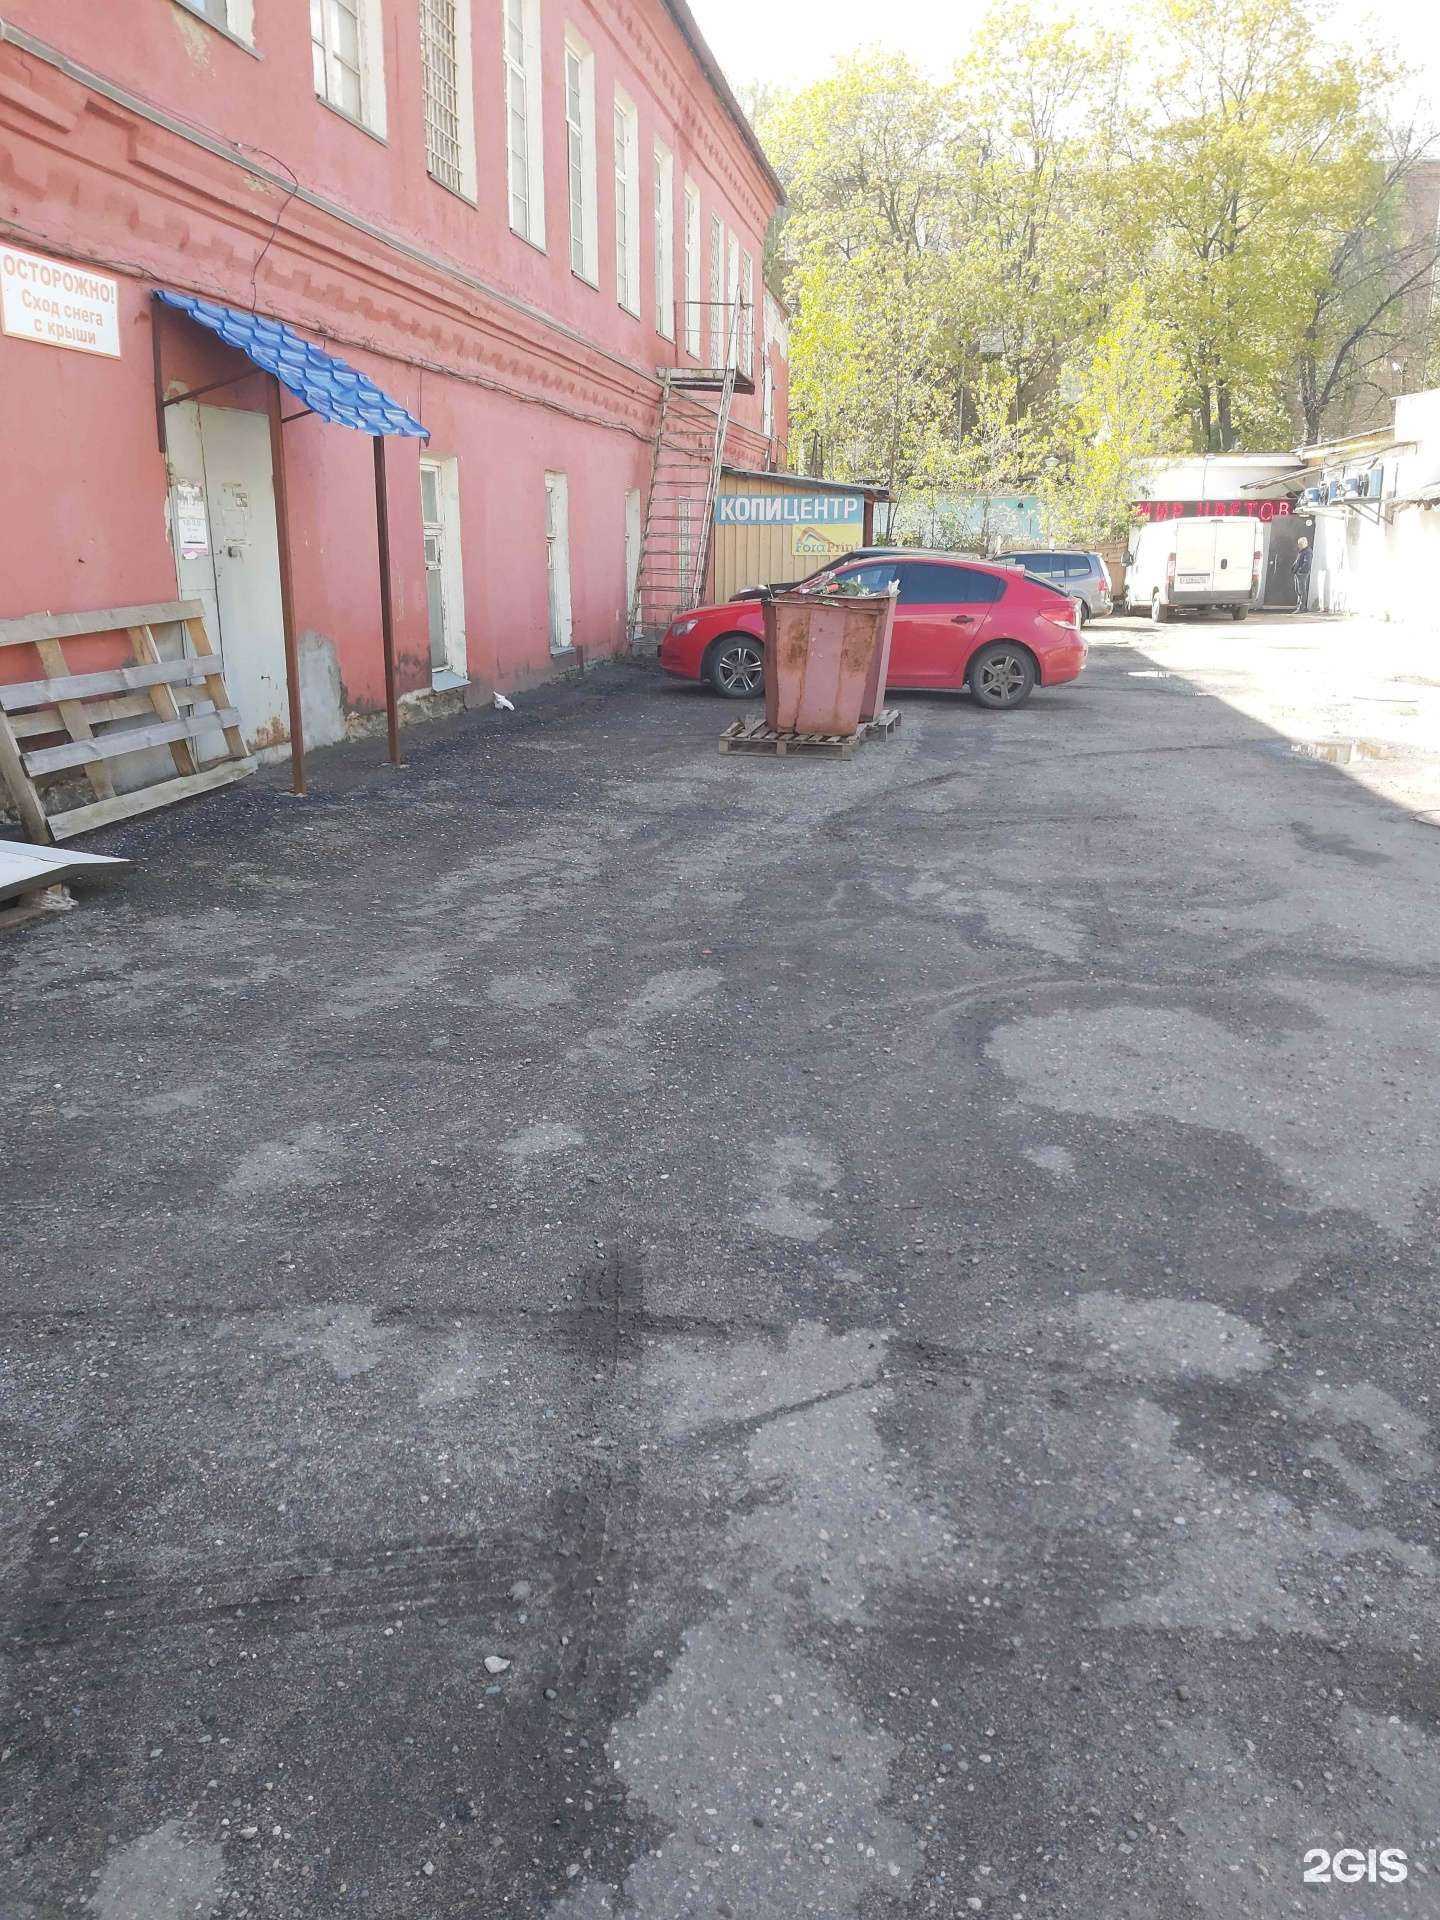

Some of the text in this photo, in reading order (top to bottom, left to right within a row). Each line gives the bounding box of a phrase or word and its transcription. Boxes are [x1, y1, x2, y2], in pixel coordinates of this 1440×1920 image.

[4, 254, 115, 304] ОСТОРОЖНО!
[22, 288, 103, 327] Сход снега
[34, 318, 96, 344] с крыши
[720, 497, 858, 522] КОПИЦЕНТР
